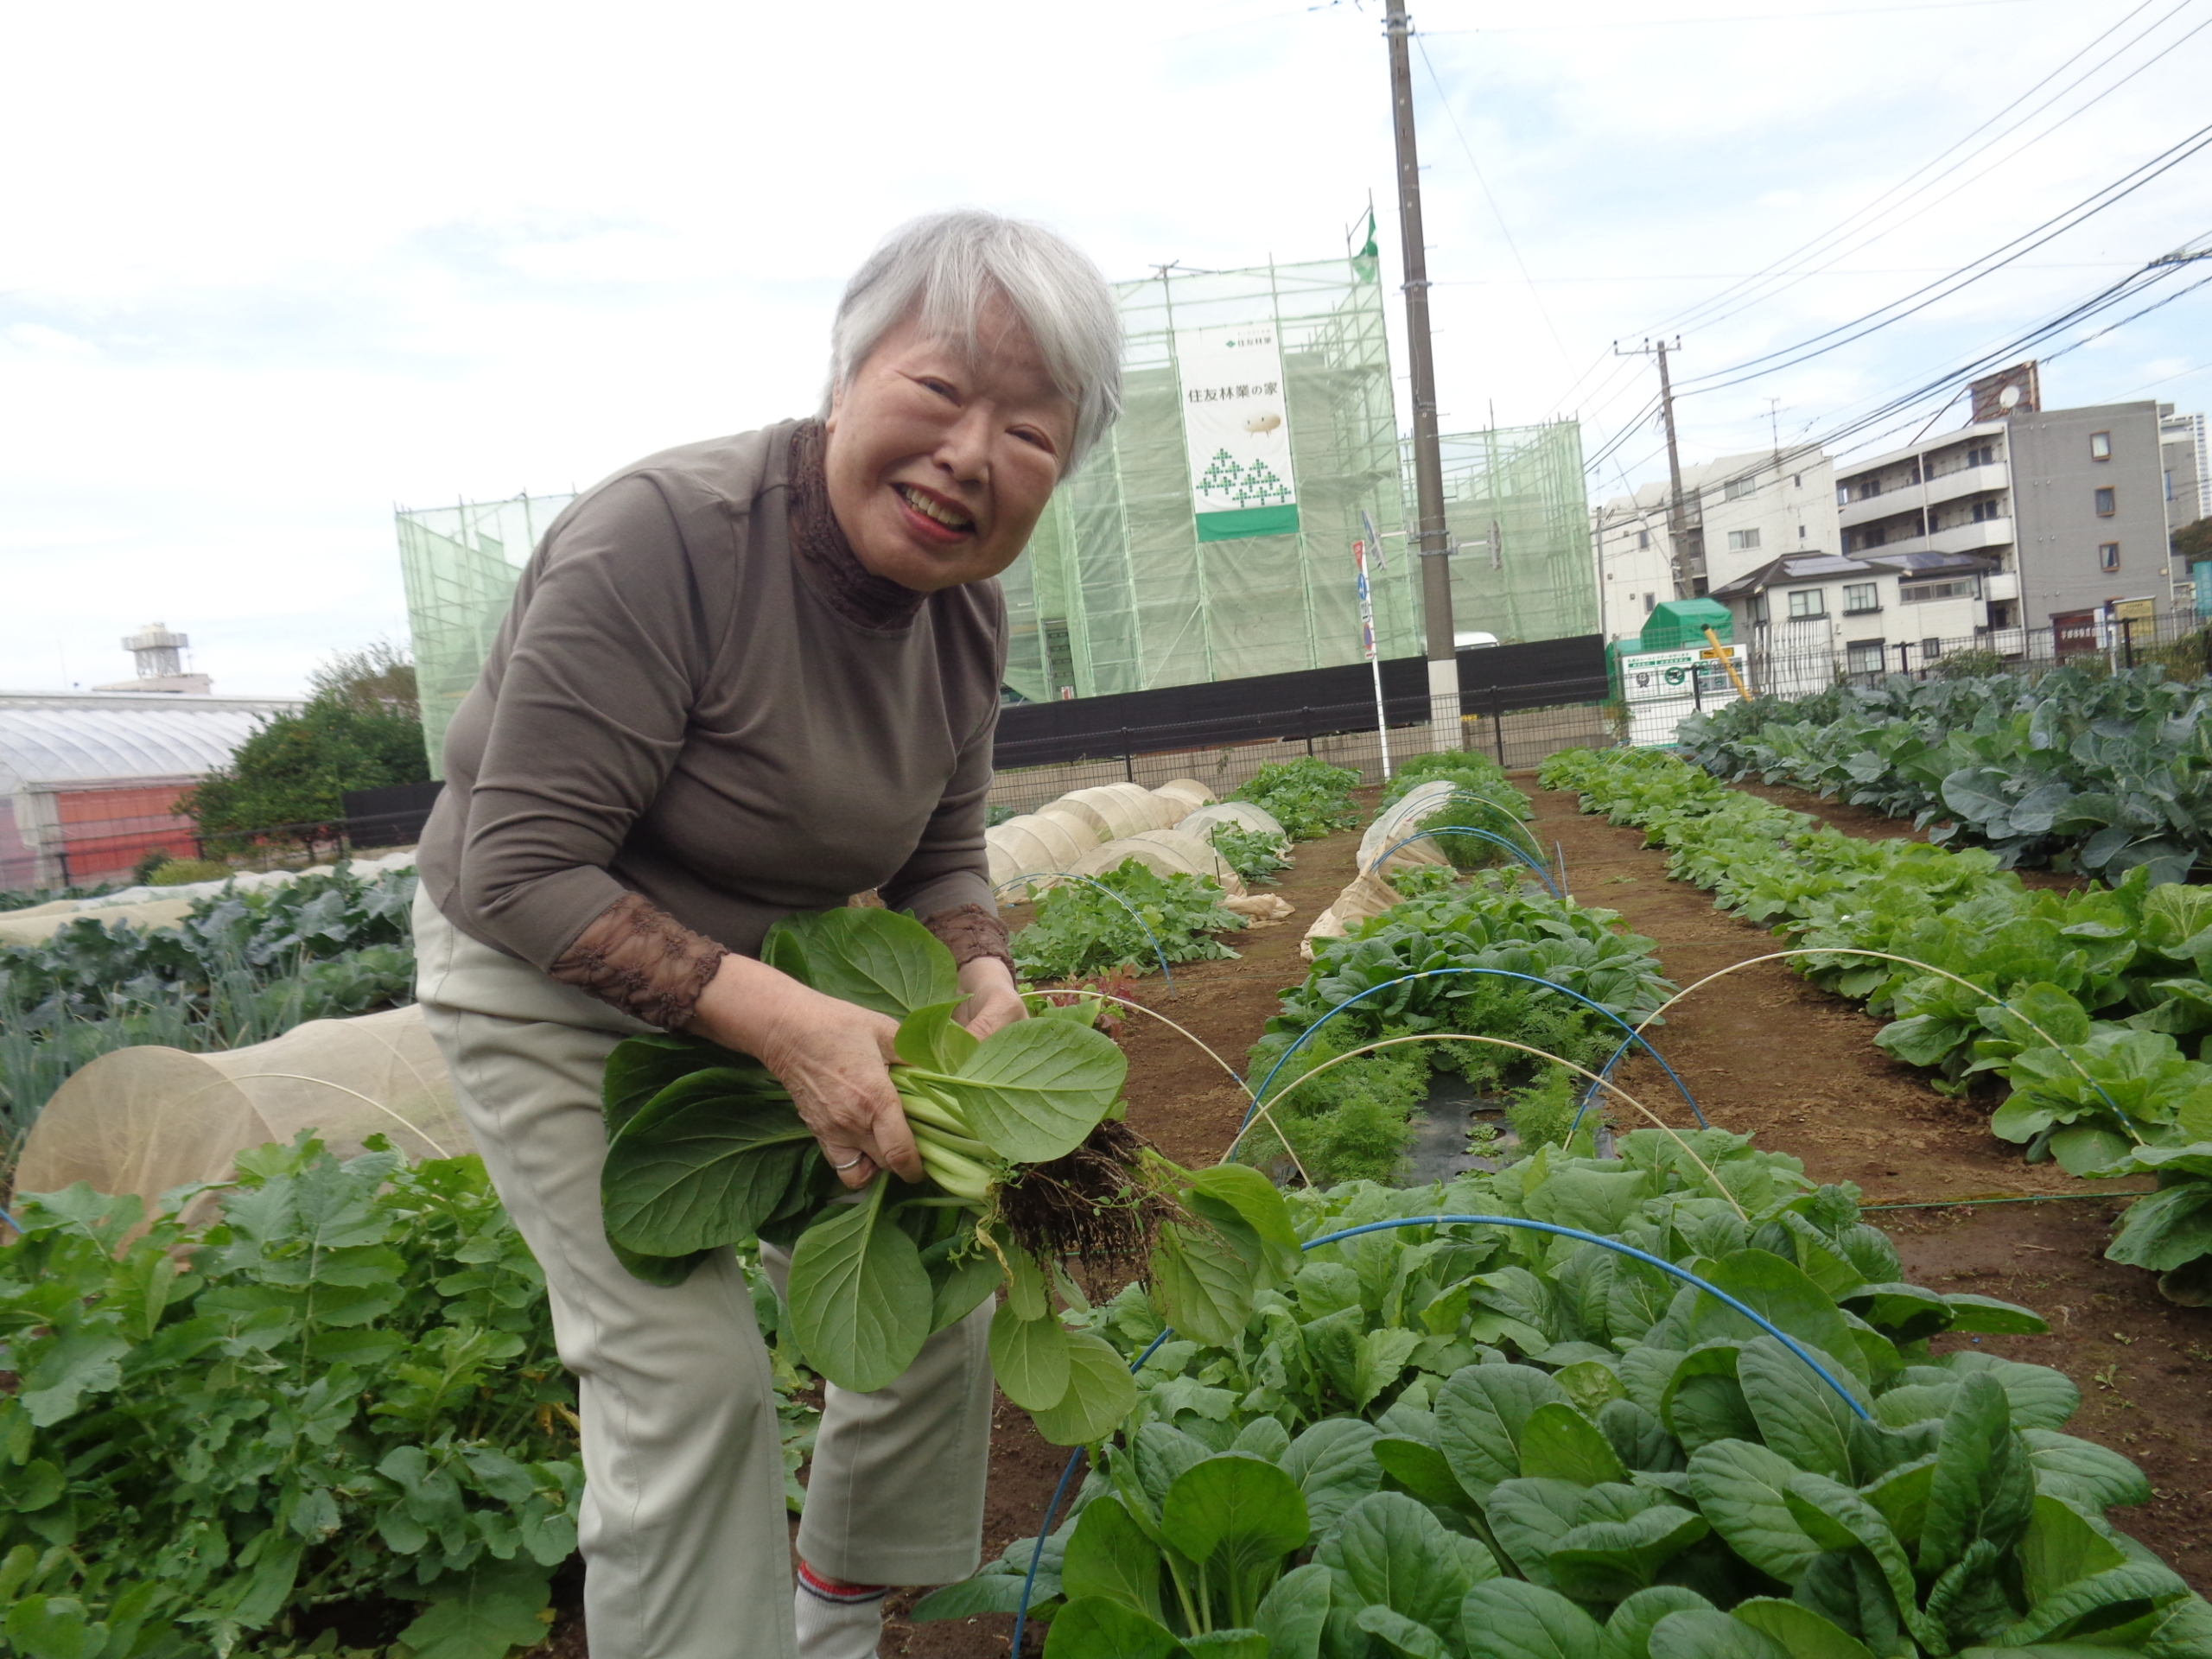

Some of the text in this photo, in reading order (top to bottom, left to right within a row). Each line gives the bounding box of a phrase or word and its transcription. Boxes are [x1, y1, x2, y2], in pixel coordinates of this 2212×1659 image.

[1187, 381, 1279, 404] 住友林業の家
